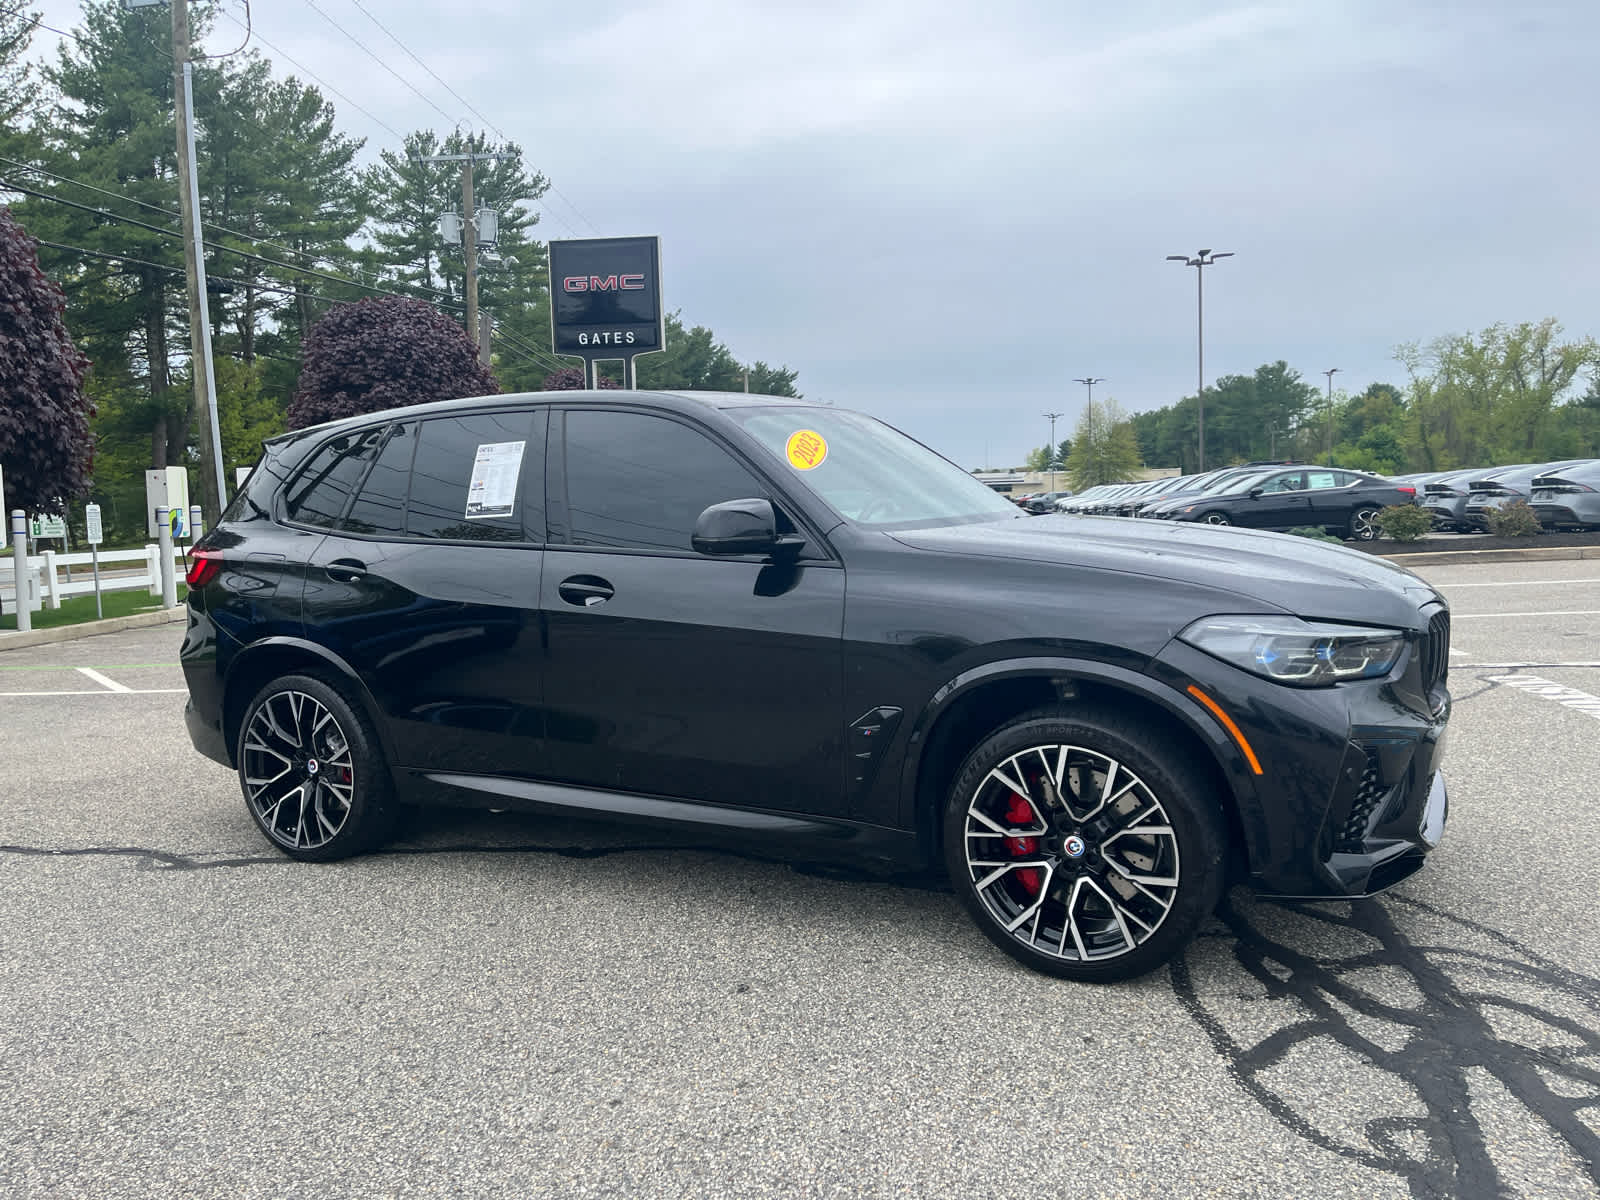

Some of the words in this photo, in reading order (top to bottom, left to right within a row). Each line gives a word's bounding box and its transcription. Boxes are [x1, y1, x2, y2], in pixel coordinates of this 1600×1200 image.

[563, 274, 645, 293] GMC
[578, 331, 635, 345] GATES
[793, 432, 821, 465] 2023
